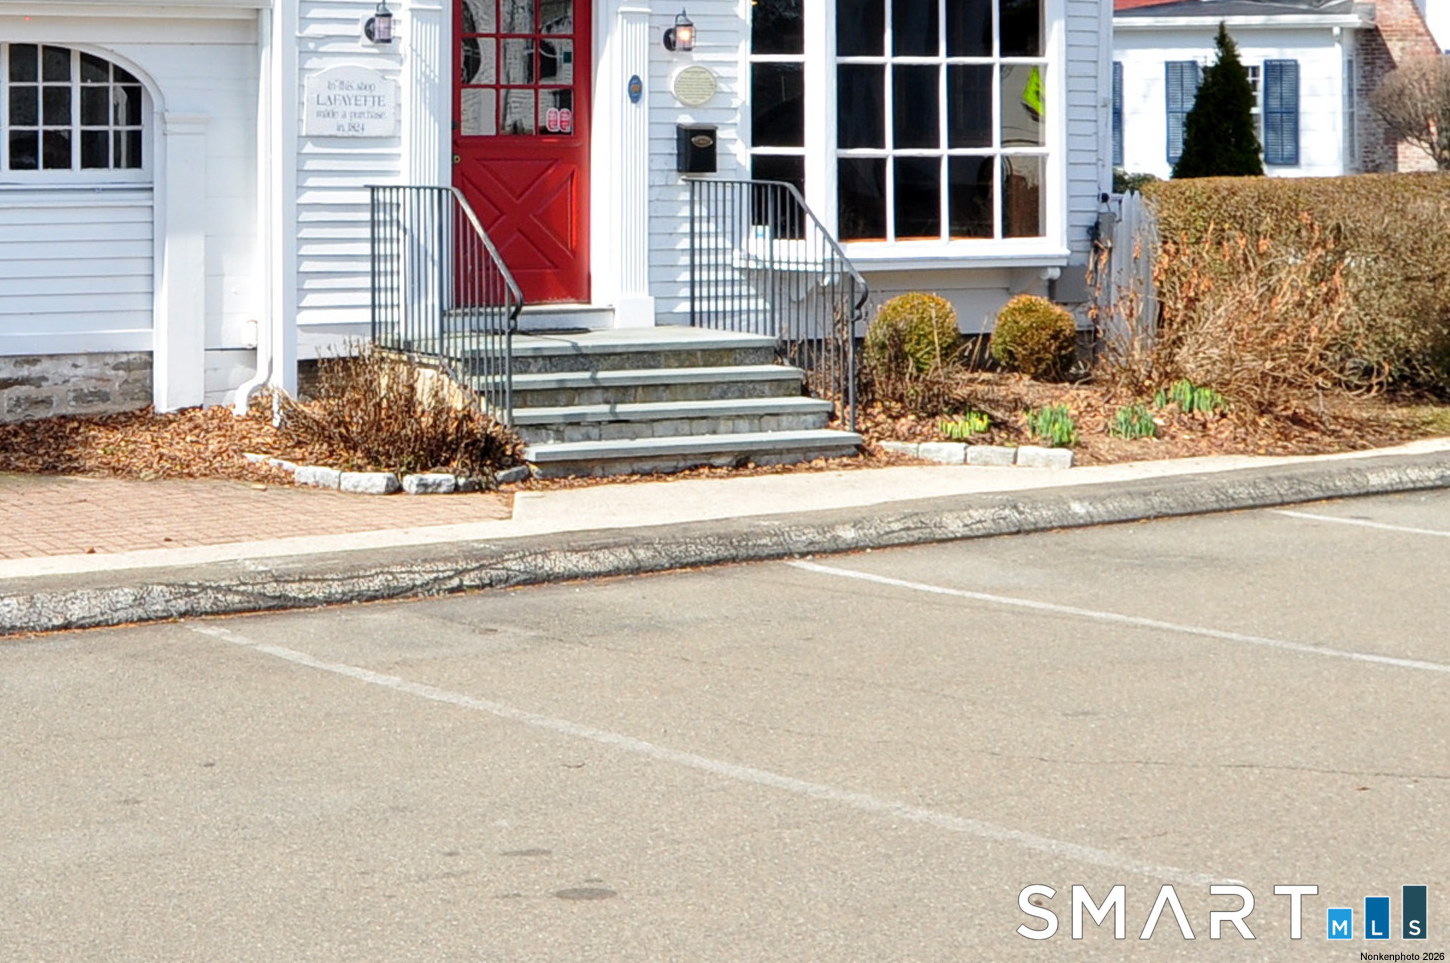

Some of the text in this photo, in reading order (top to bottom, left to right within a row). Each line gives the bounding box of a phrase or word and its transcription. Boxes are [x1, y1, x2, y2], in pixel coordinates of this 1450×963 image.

[357, 81, 376, 94] shop
[316, 94, 386, 107] LAFAYETTE
[316, 108, 339, 118] made
[350, 109, 386, 121] purchase
